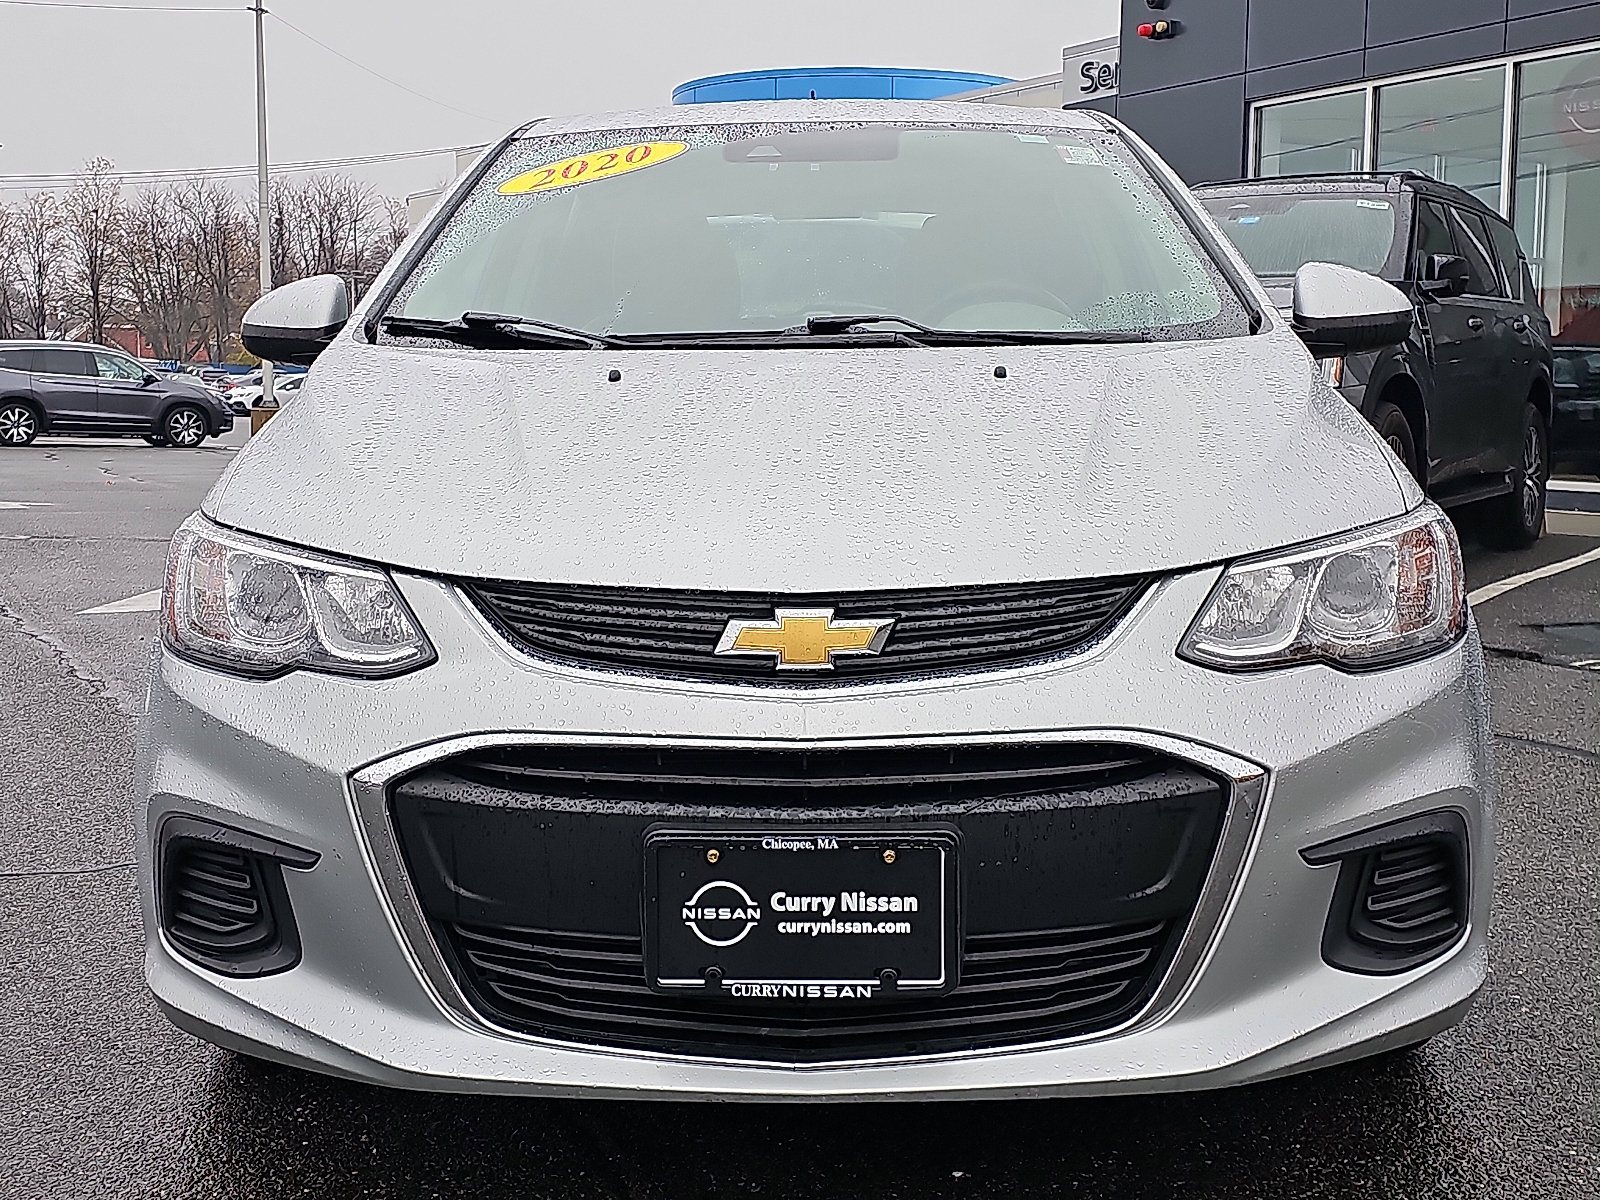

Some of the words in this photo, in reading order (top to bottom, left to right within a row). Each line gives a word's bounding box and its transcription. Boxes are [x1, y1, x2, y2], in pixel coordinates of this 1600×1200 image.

[528, 145, 652, 189] 2020
[762, 838, 814, 851] Chicopee,
[816, 838, 839, 850] MA
[771, 892, 836, 916] Curry
[841, 892, 918, 912] Nissan
[682, 908, 760, 920] NISSAN
[777, 919, 911, 936] currynissan.com
